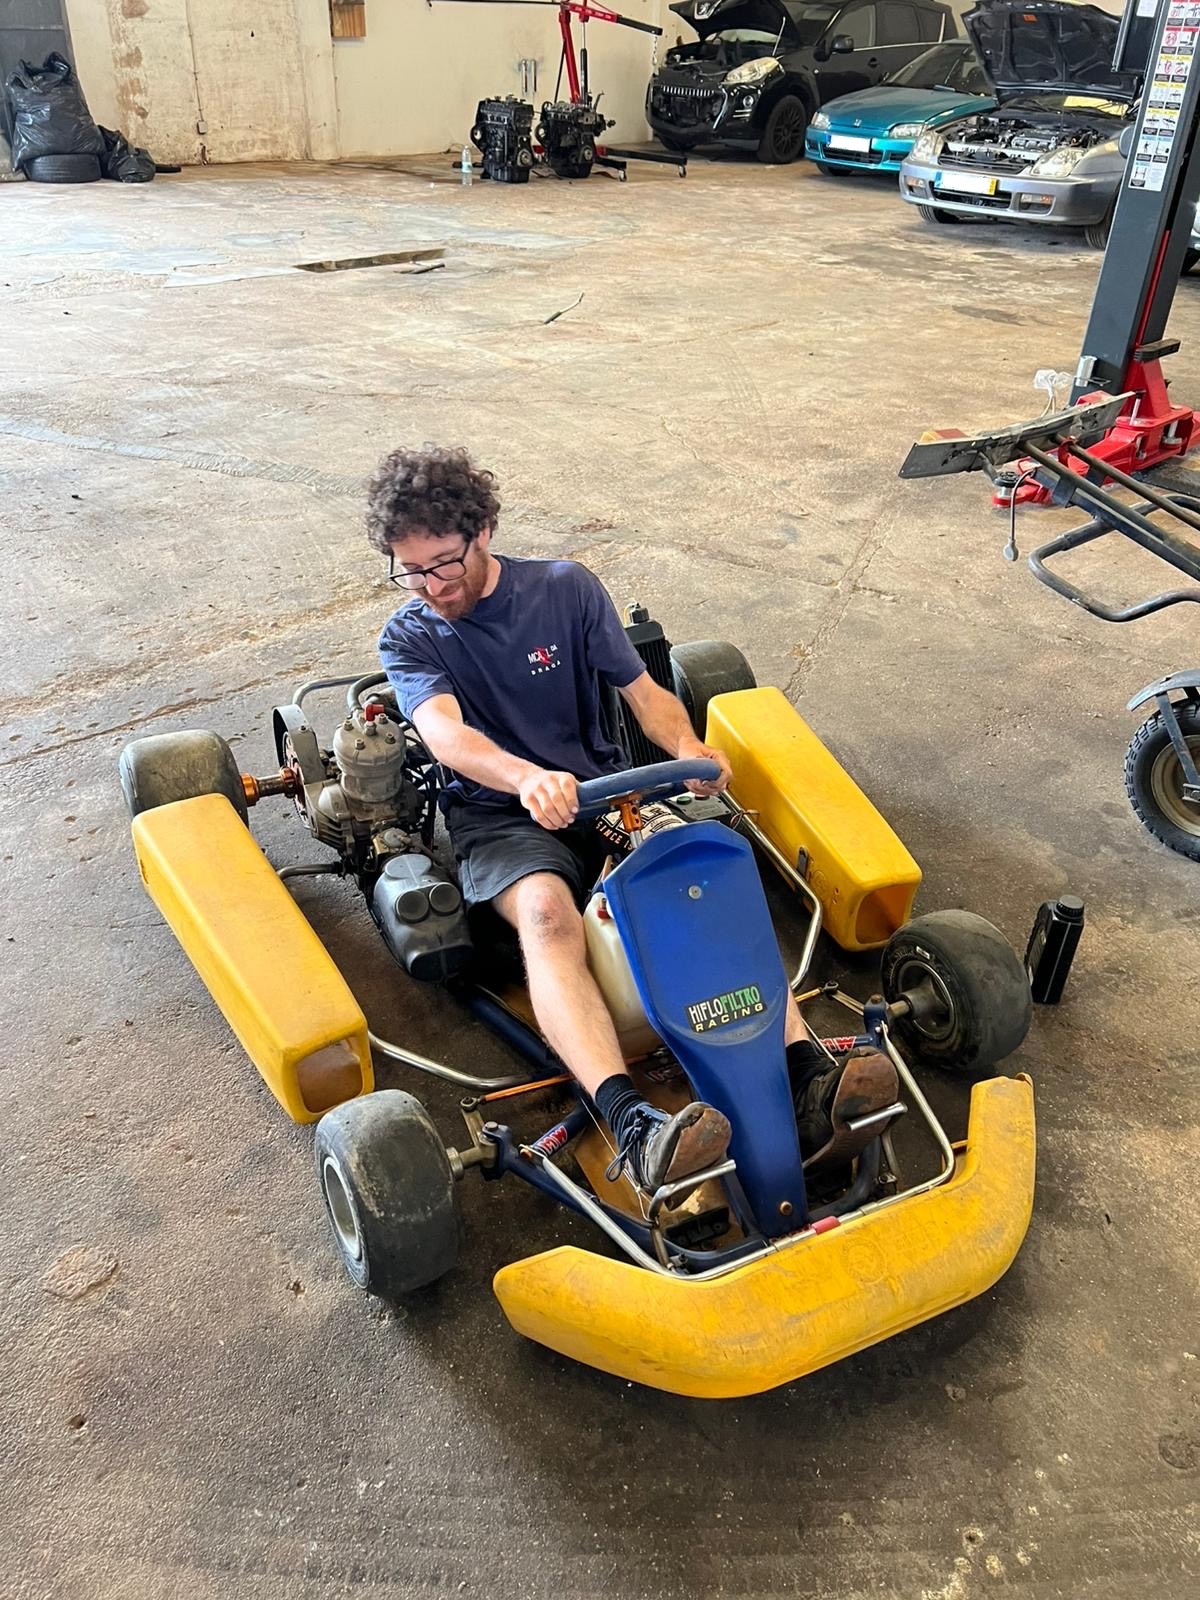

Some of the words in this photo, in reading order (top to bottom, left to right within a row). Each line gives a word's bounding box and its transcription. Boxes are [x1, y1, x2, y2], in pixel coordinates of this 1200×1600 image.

[531, 660, 561, 676] BRAGA
[596, 822, 622, 845] SINCE
[688, 985, 760, 1025] HIFLOFILTRO
[695, 1002, 764, 1033] RACING
